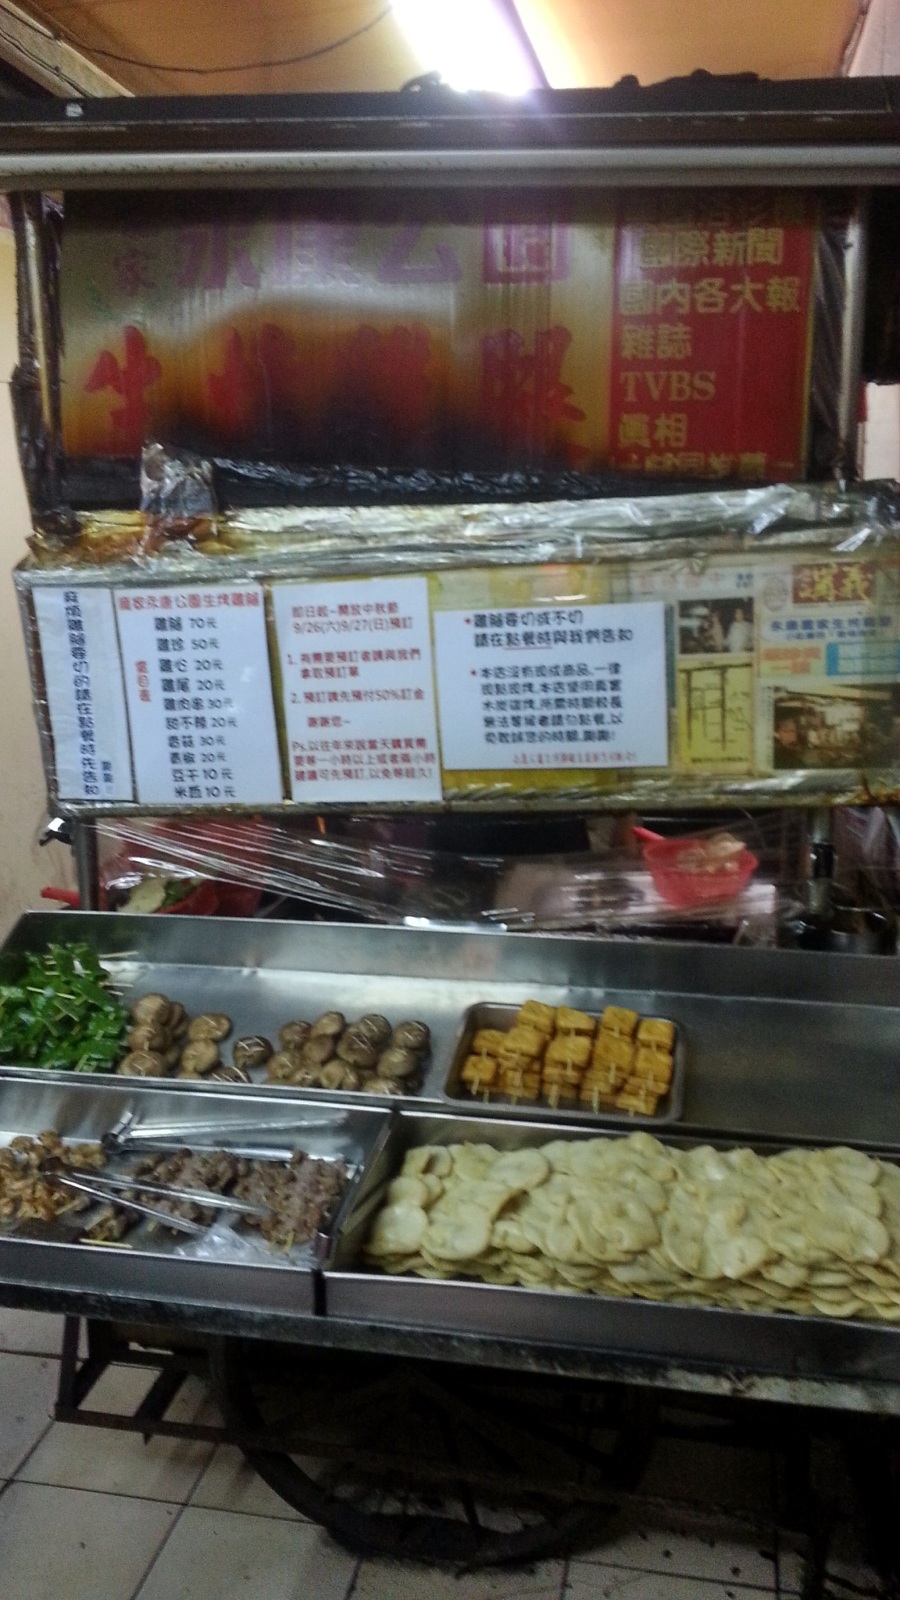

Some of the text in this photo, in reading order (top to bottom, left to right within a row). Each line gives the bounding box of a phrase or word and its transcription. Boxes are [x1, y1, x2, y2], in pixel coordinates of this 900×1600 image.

[640, 227, 784, 267] 國際新聞
[619, 277, 801, 315] 國內各大報
[621, 322, 692, 361] 雜誌
[621, 371, 717, 403] TVBS
[189, 617, 218, 629] 70元
[191, 638, 220, 650] 50元
[159, 659, 224, 673] 雞心 20元
[196, 678, 226, 691] 20元
[207, 698, 235, 709] 30元
[166, 716, 239, 730] 甜不辣 20元
[199, 736, 227, 746] 30元
[200, 752, 227, 763] 20元
[172, 768, 234, 782] 豆干 10元
[174, 785, 237, 799] 米血 10元
